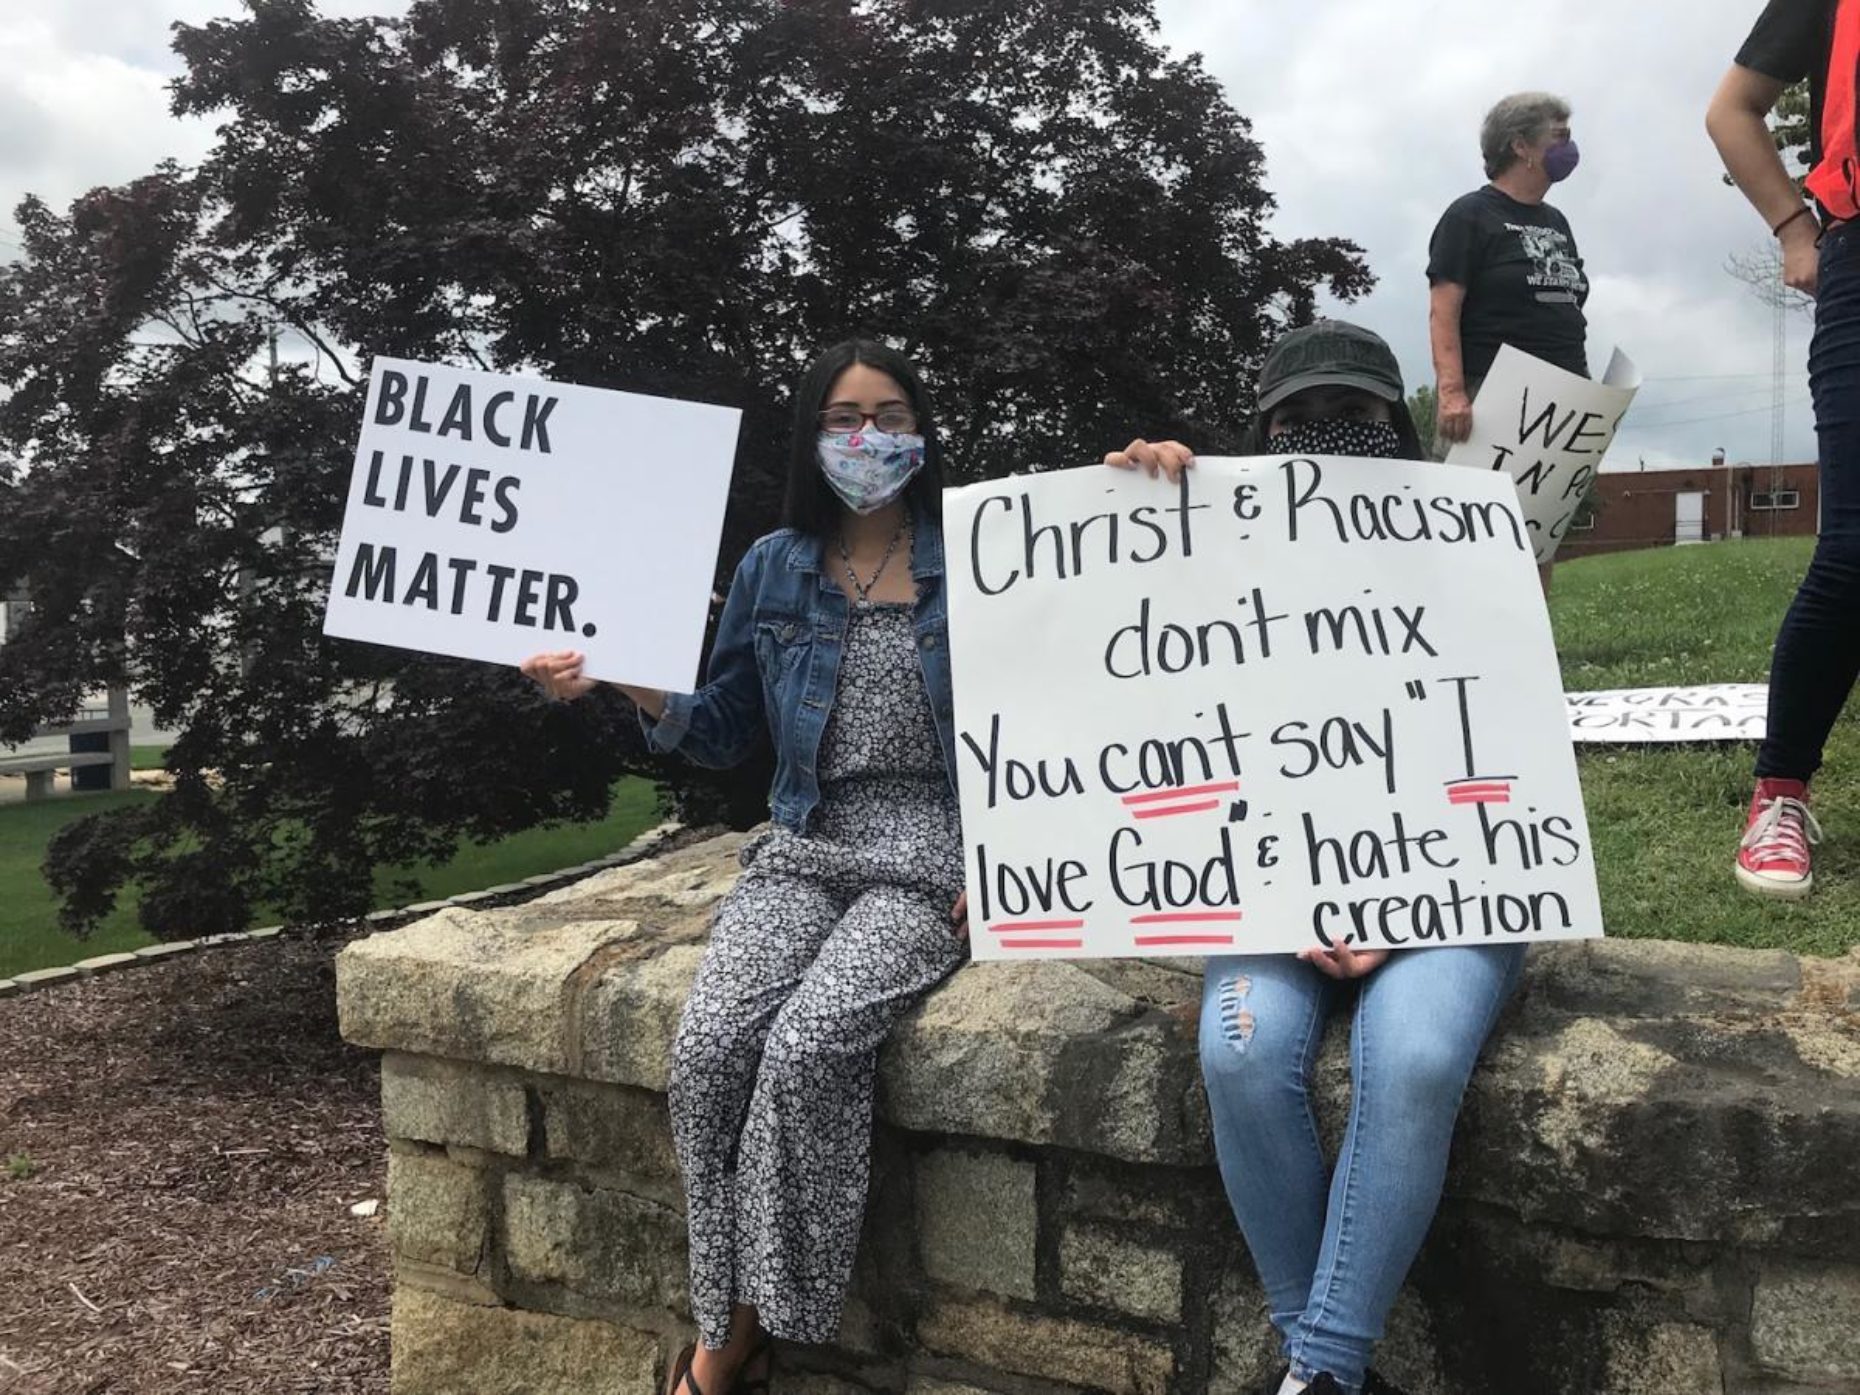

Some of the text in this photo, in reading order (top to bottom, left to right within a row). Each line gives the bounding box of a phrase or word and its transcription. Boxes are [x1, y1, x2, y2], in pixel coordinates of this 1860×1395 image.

[374, 370, 559, 453] BLACK
[363, 450, 521, 533] LIVES
[971, 459, 1526, 595] Christ & Racism
[345, 543, 597, 638] MATTER.
[1105, 588, 1439, 678] don't mix
[960, 713, 1084, 808] You
[1271, 708, 1395, 794] say
[977, 844, 1093, 921] love
[1302, 812, 1459, 886] hate
[1477, 800, 1580, 870] his
[1313, 879, 1572, 949] creation
